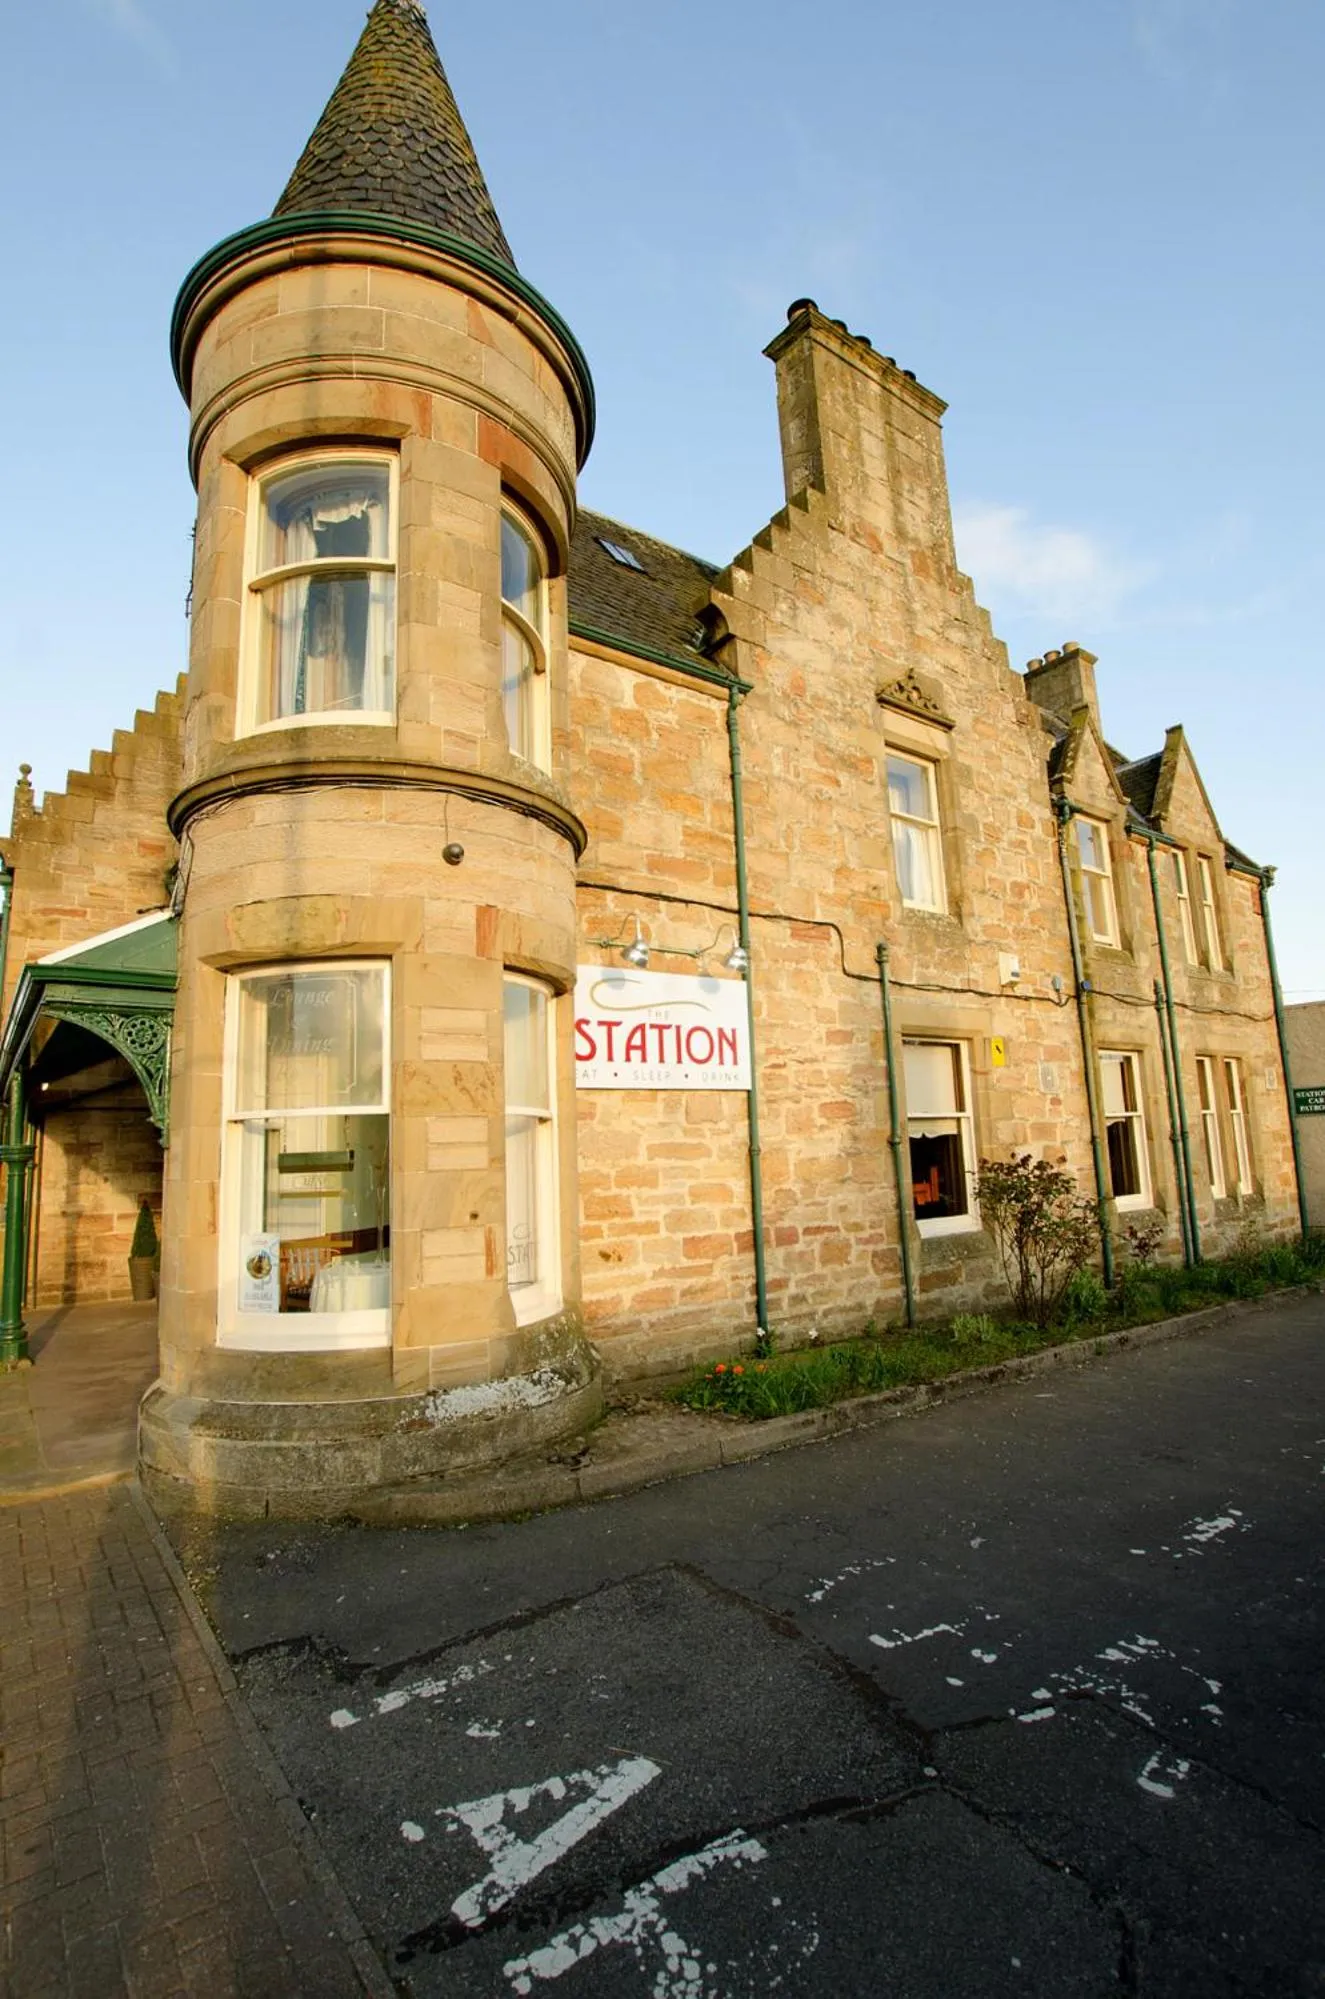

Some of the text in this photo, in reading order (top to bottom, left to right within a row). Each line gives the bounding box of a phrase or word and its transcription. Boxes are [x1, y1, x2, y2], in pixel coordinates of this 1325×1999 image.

[575, 1018, 738, 1066] STATION
[633, 1069, 671, 1082] SLEEP
[702, 1072, 740, 1082] DRINK
